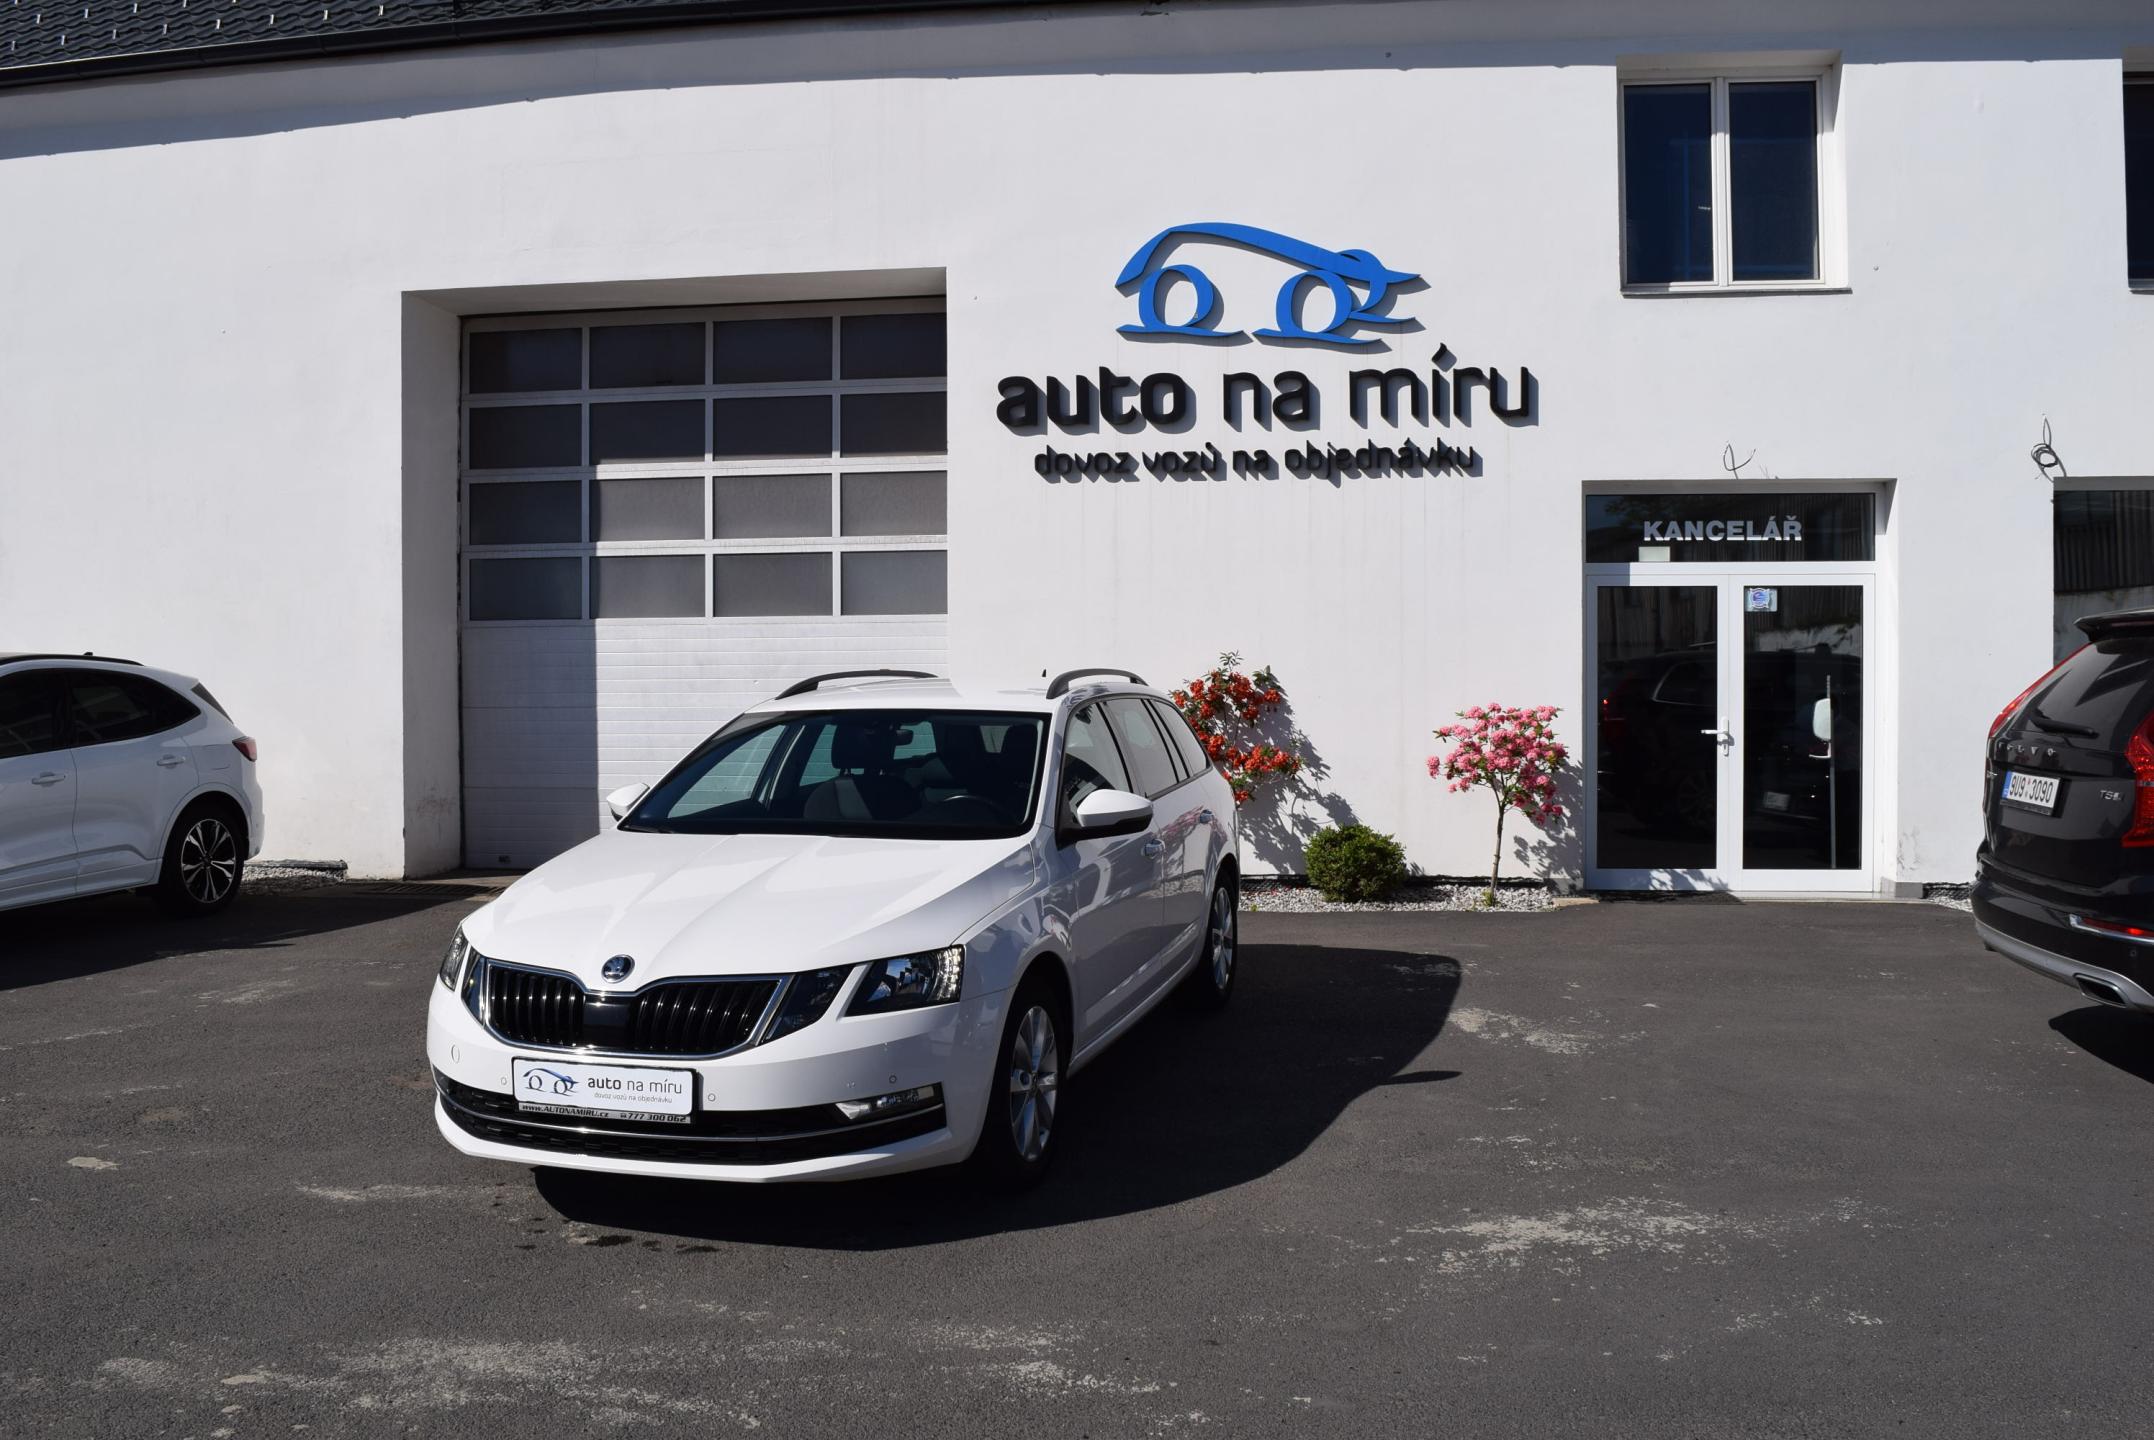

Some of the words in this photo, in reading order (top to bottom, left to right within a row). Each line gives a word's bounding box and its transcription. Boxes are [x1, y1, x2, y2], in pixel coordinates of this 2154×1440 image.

[997, 366, 1188, 427] auto
[1223, 370, 1311, 423] na
[1349, 342, 1530, 419] míru
[1034, 444, 1132, 475] dovoz
[1232, 449, 1269, 472] na
[1284, 437, 1475, 480] objednávku
[1643, 515, 1803, 542] KANCELÁŘ
[2009, 775, 2026, 798] 9U9
[2029, 779, 2054, 804] 3090
[587, 1076, 622, 1090] auto
[627, 1080, 644, 1092] na
[649, 1078, 682, 1094] míru
[628, 1112, 645, 1120] 777
